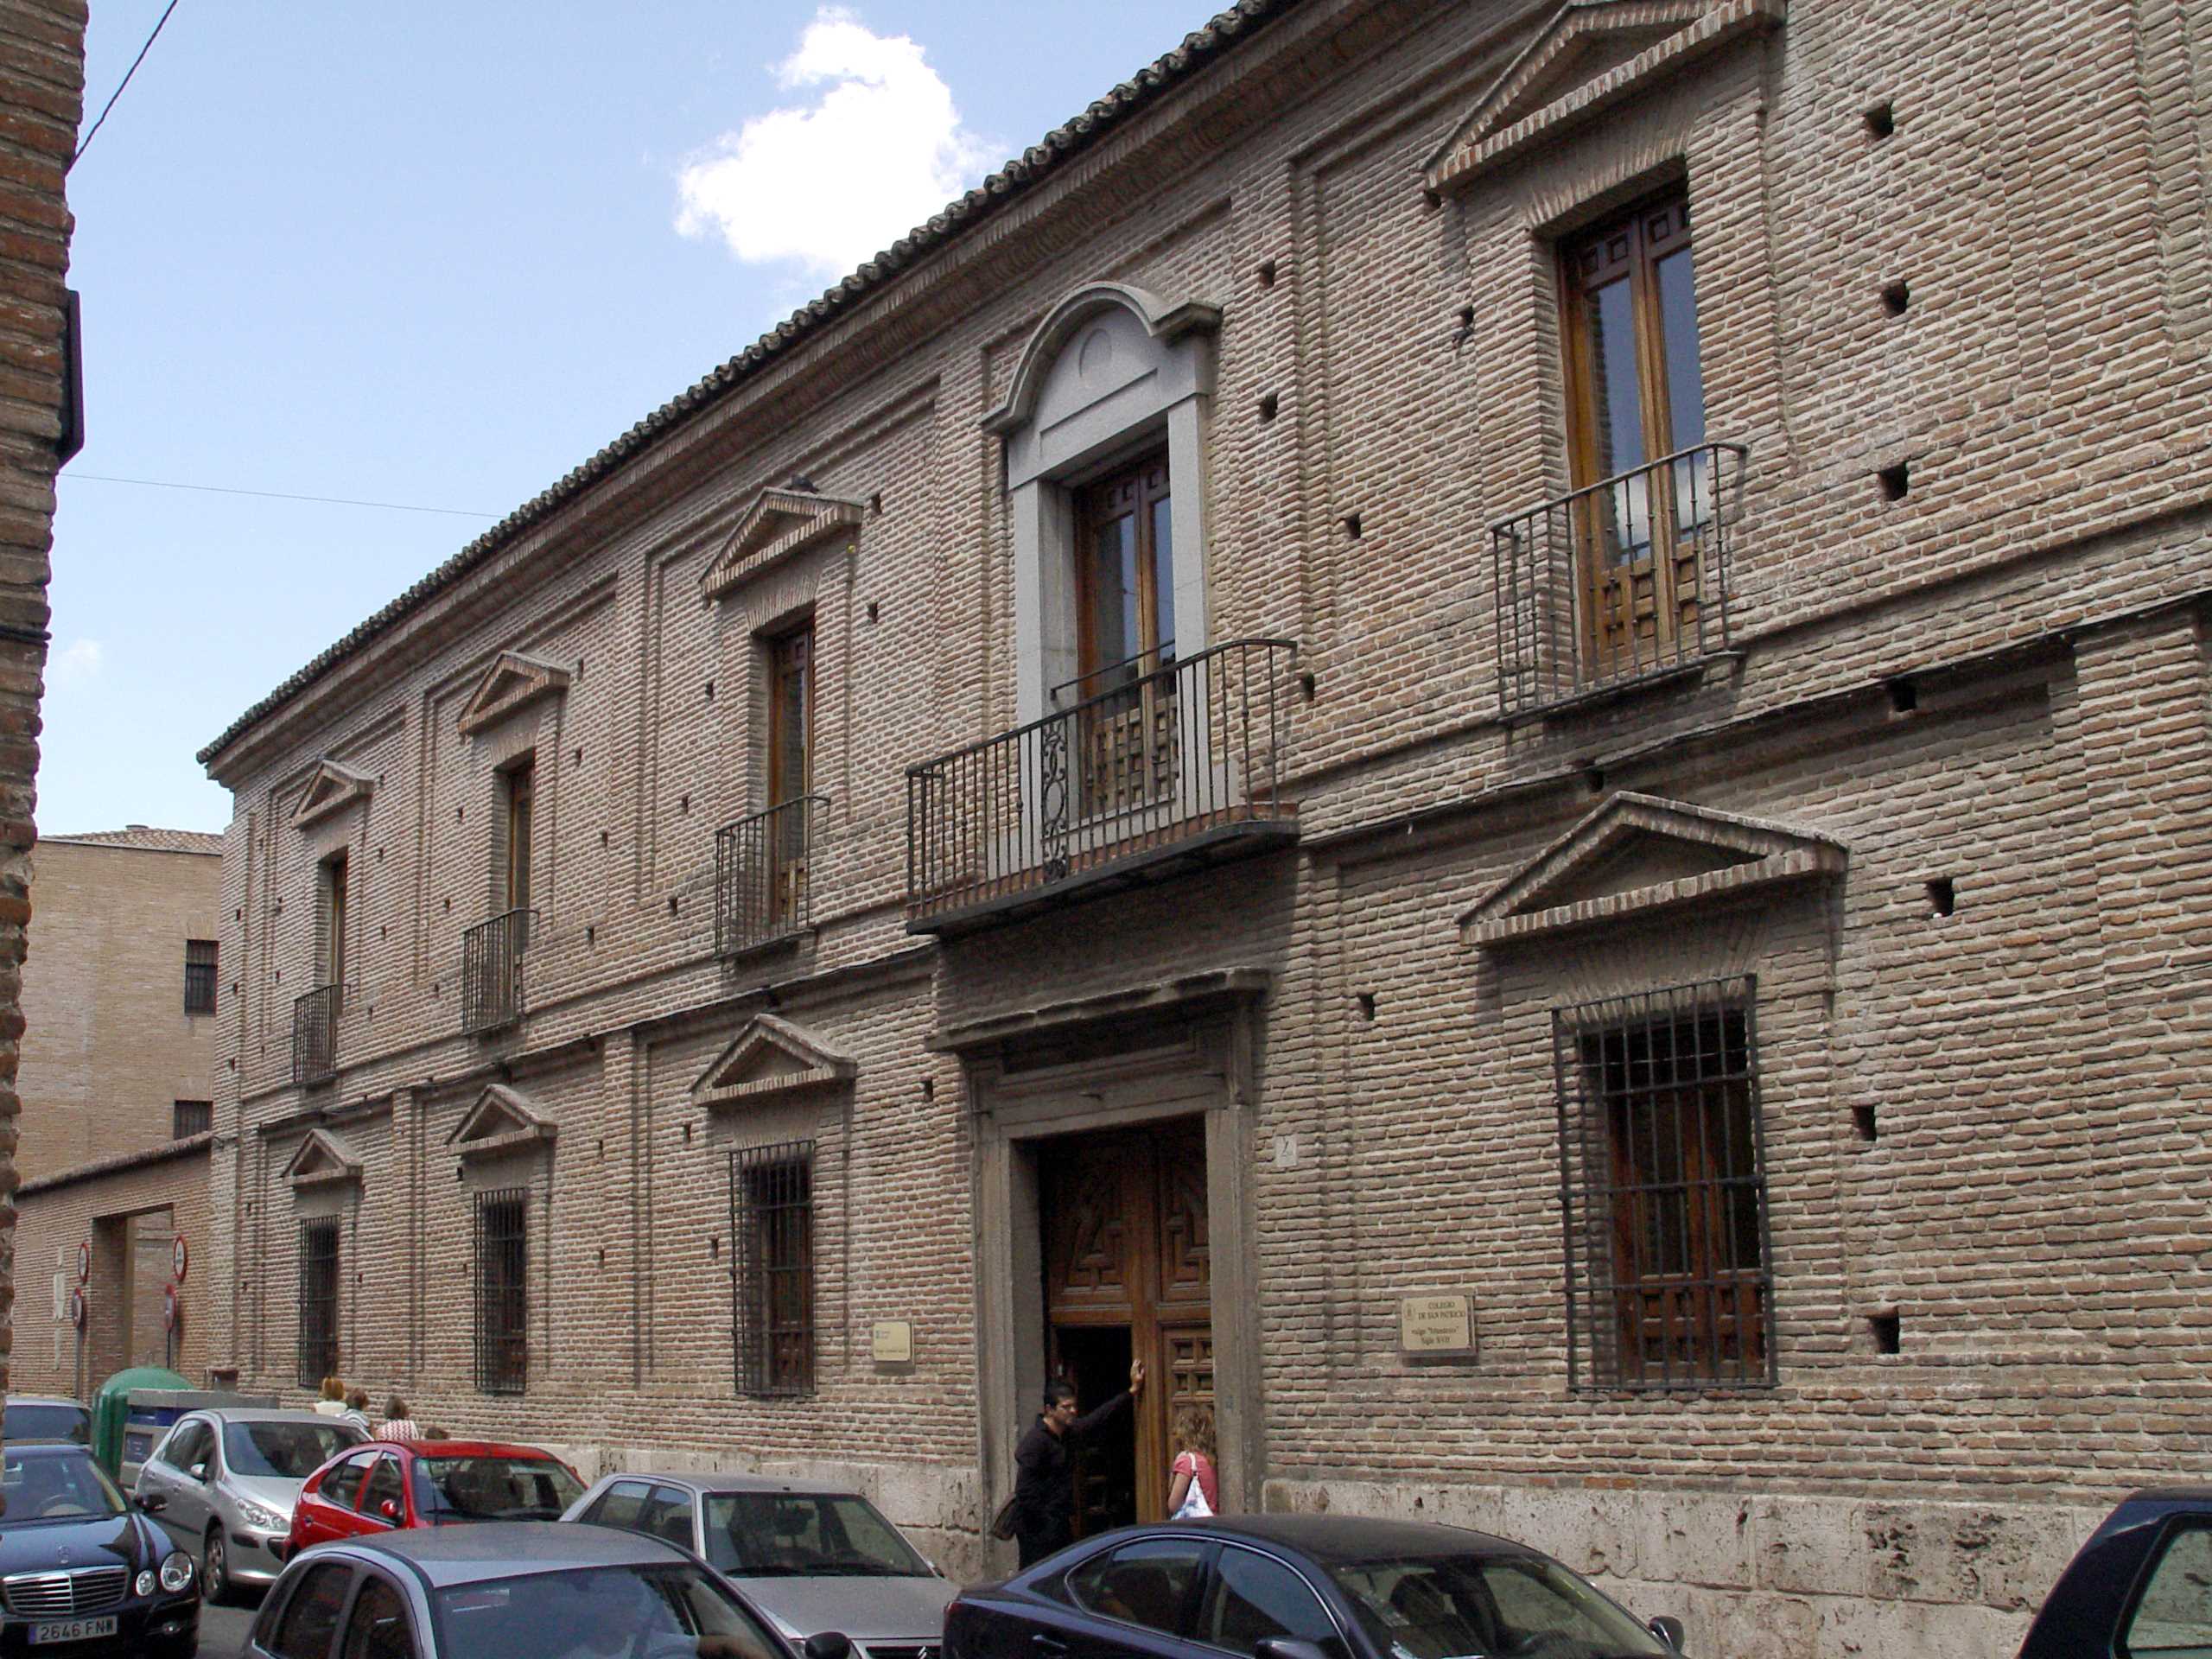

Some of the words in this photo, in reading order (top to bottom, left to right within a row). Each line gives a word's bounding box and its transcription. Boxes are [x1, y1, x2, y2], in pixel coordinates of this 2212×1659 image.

[1418, 1312, 1427, 1321] DE
[1427, 1311, 1439, 1319] SAN
[1440, 1310, 1466, 1319] PATRICIO
[40, 1622, 81, 1641] 2646
